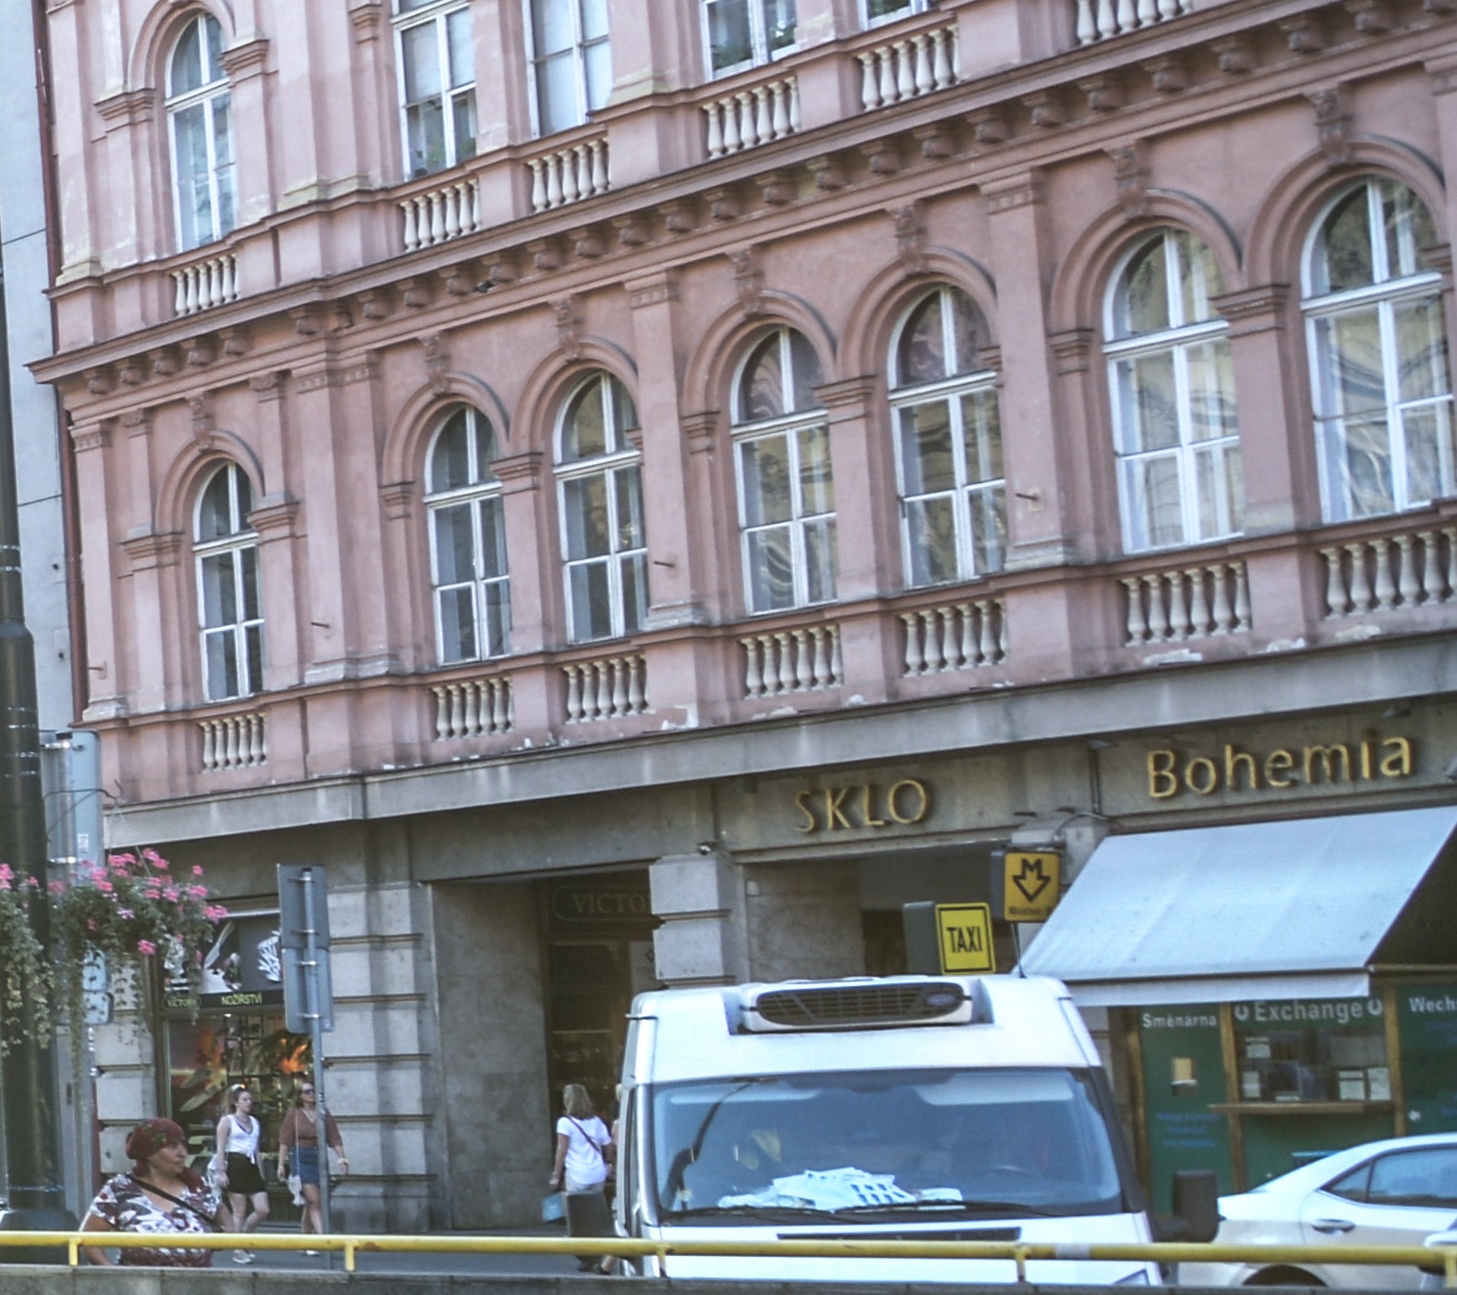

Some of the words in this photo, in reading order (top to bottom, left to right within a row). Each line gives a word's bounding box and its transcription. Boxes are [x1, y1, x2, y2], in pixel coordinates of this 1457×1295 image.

[796, 777, 931, 835] SKLO
[1146, 734, 1417, 801] Bohemia
[945, 925, 984, 954] TAXI
[1254, 1000, 1364, 1024] Exchange
[1409, 996, 1457, 1014] Wech
